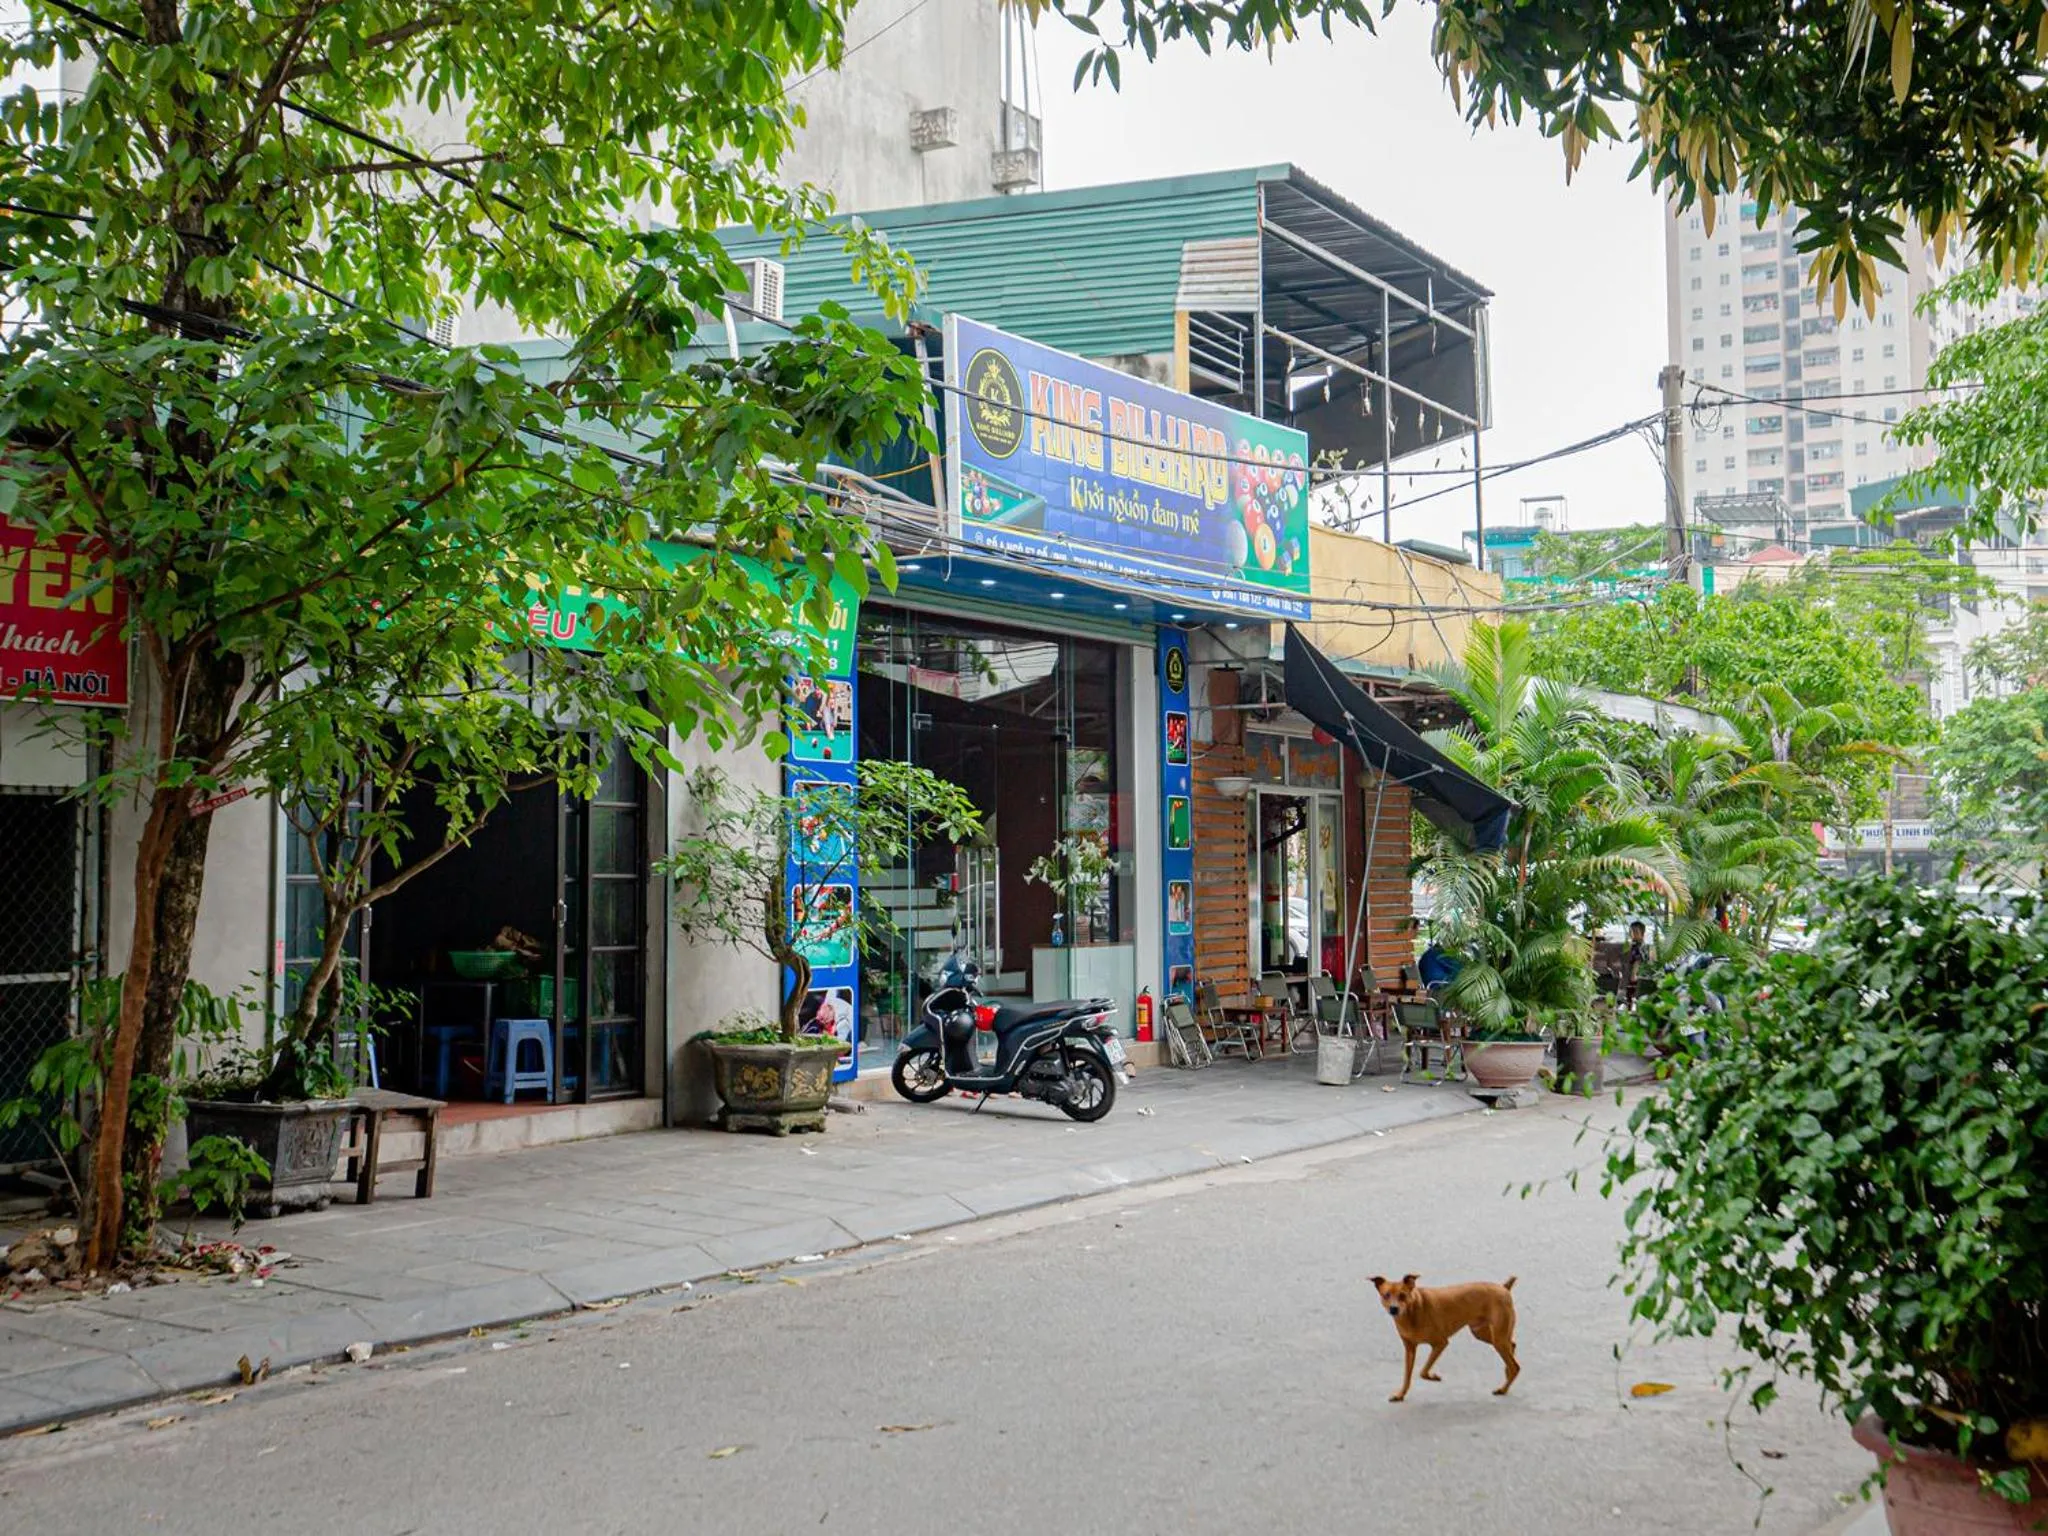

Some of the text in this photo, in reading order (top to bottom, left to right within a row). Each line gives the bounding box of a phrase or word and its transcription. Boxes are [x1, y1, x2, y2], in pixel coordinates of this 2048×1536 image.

[1028, 370, 1230, 510] KING BILLIARD
[1152, 498, 1179, 533] đam
[1181, 508, 1200, 536] mê
[23, 665, 58, 693] HÀ
[62, 668, 110, 699] NỘI
